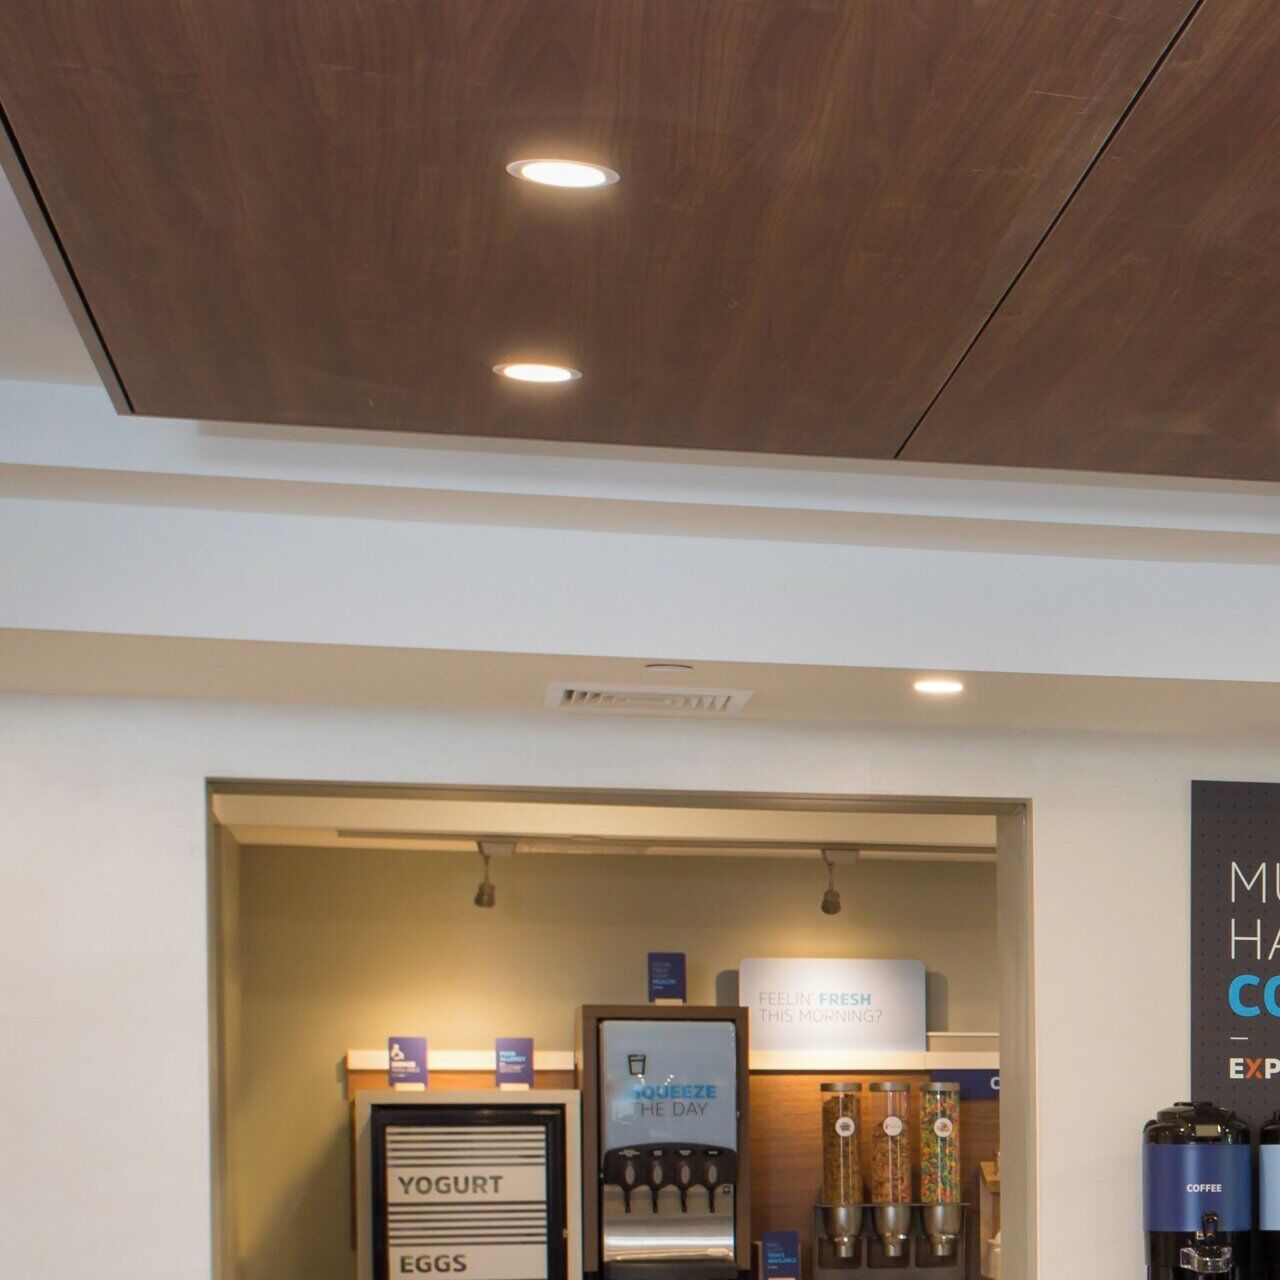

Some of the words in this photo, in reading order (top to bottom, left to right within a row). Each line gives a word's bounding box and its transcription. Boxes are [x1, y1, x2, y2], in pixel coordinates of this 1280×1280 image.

[819, 992, 871, 1006] FRESH
[759, 1008, 793, 1023] THIS
[800, 1008, 883, 1023] MORNING?
[672, 1101, 709, 1117] DAY
[398, 1175, 504, 1195] YOGURT
[1186, 1183, 1222, 1193] COFFEE
[399, 1254, 467, 1274] EGGS
